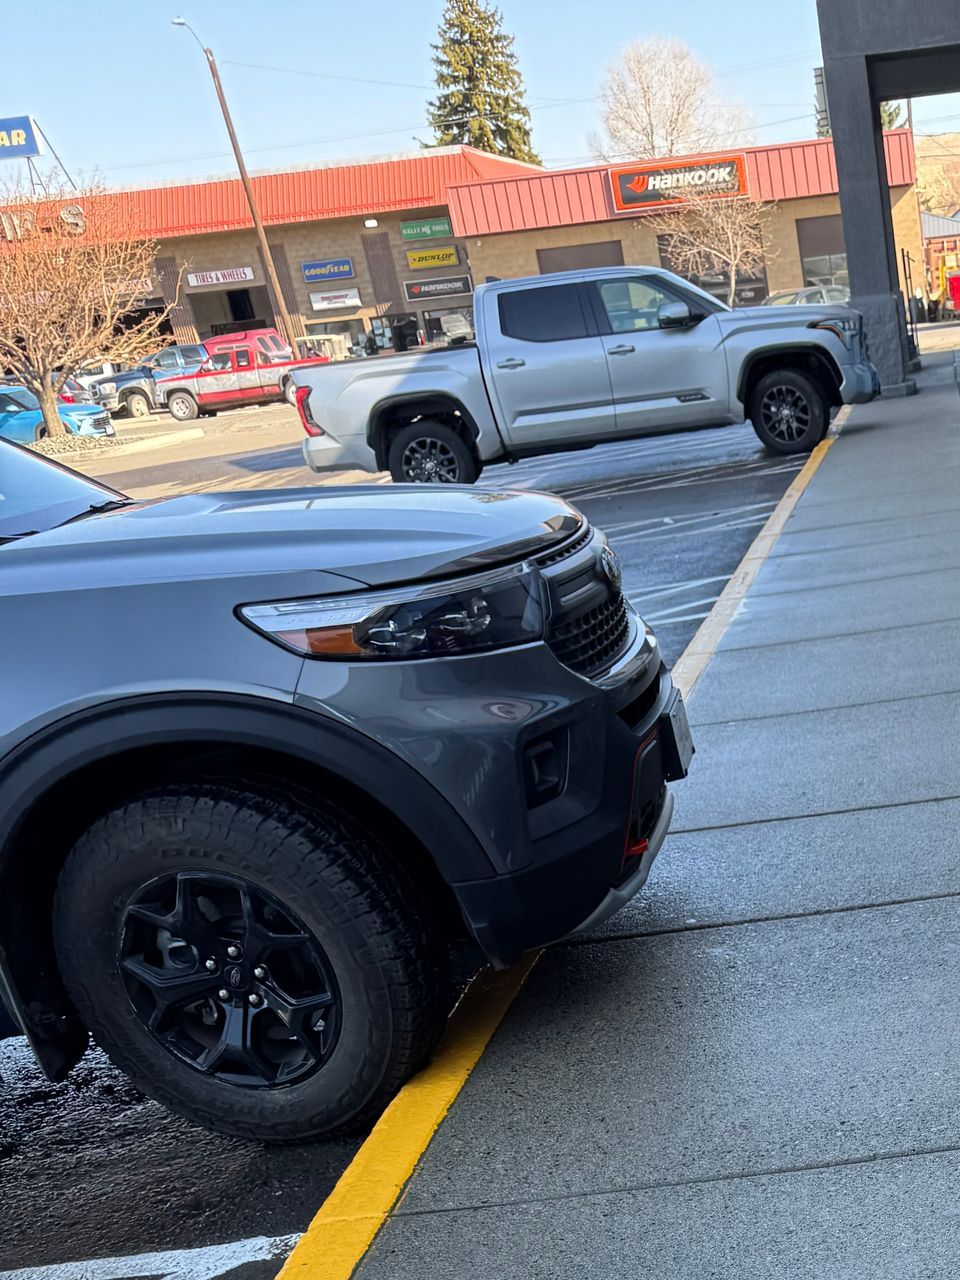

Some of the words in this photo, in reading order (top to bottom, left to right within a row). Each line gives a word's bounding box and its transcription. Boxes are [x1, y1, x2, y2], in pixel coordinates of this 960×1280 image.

[417, 252, 454, 262] DUNLOP
[305, 264, 350, 276] GOODYEAR
[194, 272, 214, 285] TIRES
[214, 273, 220, 282] &
[220, 268, 248, 282] WHEELS
